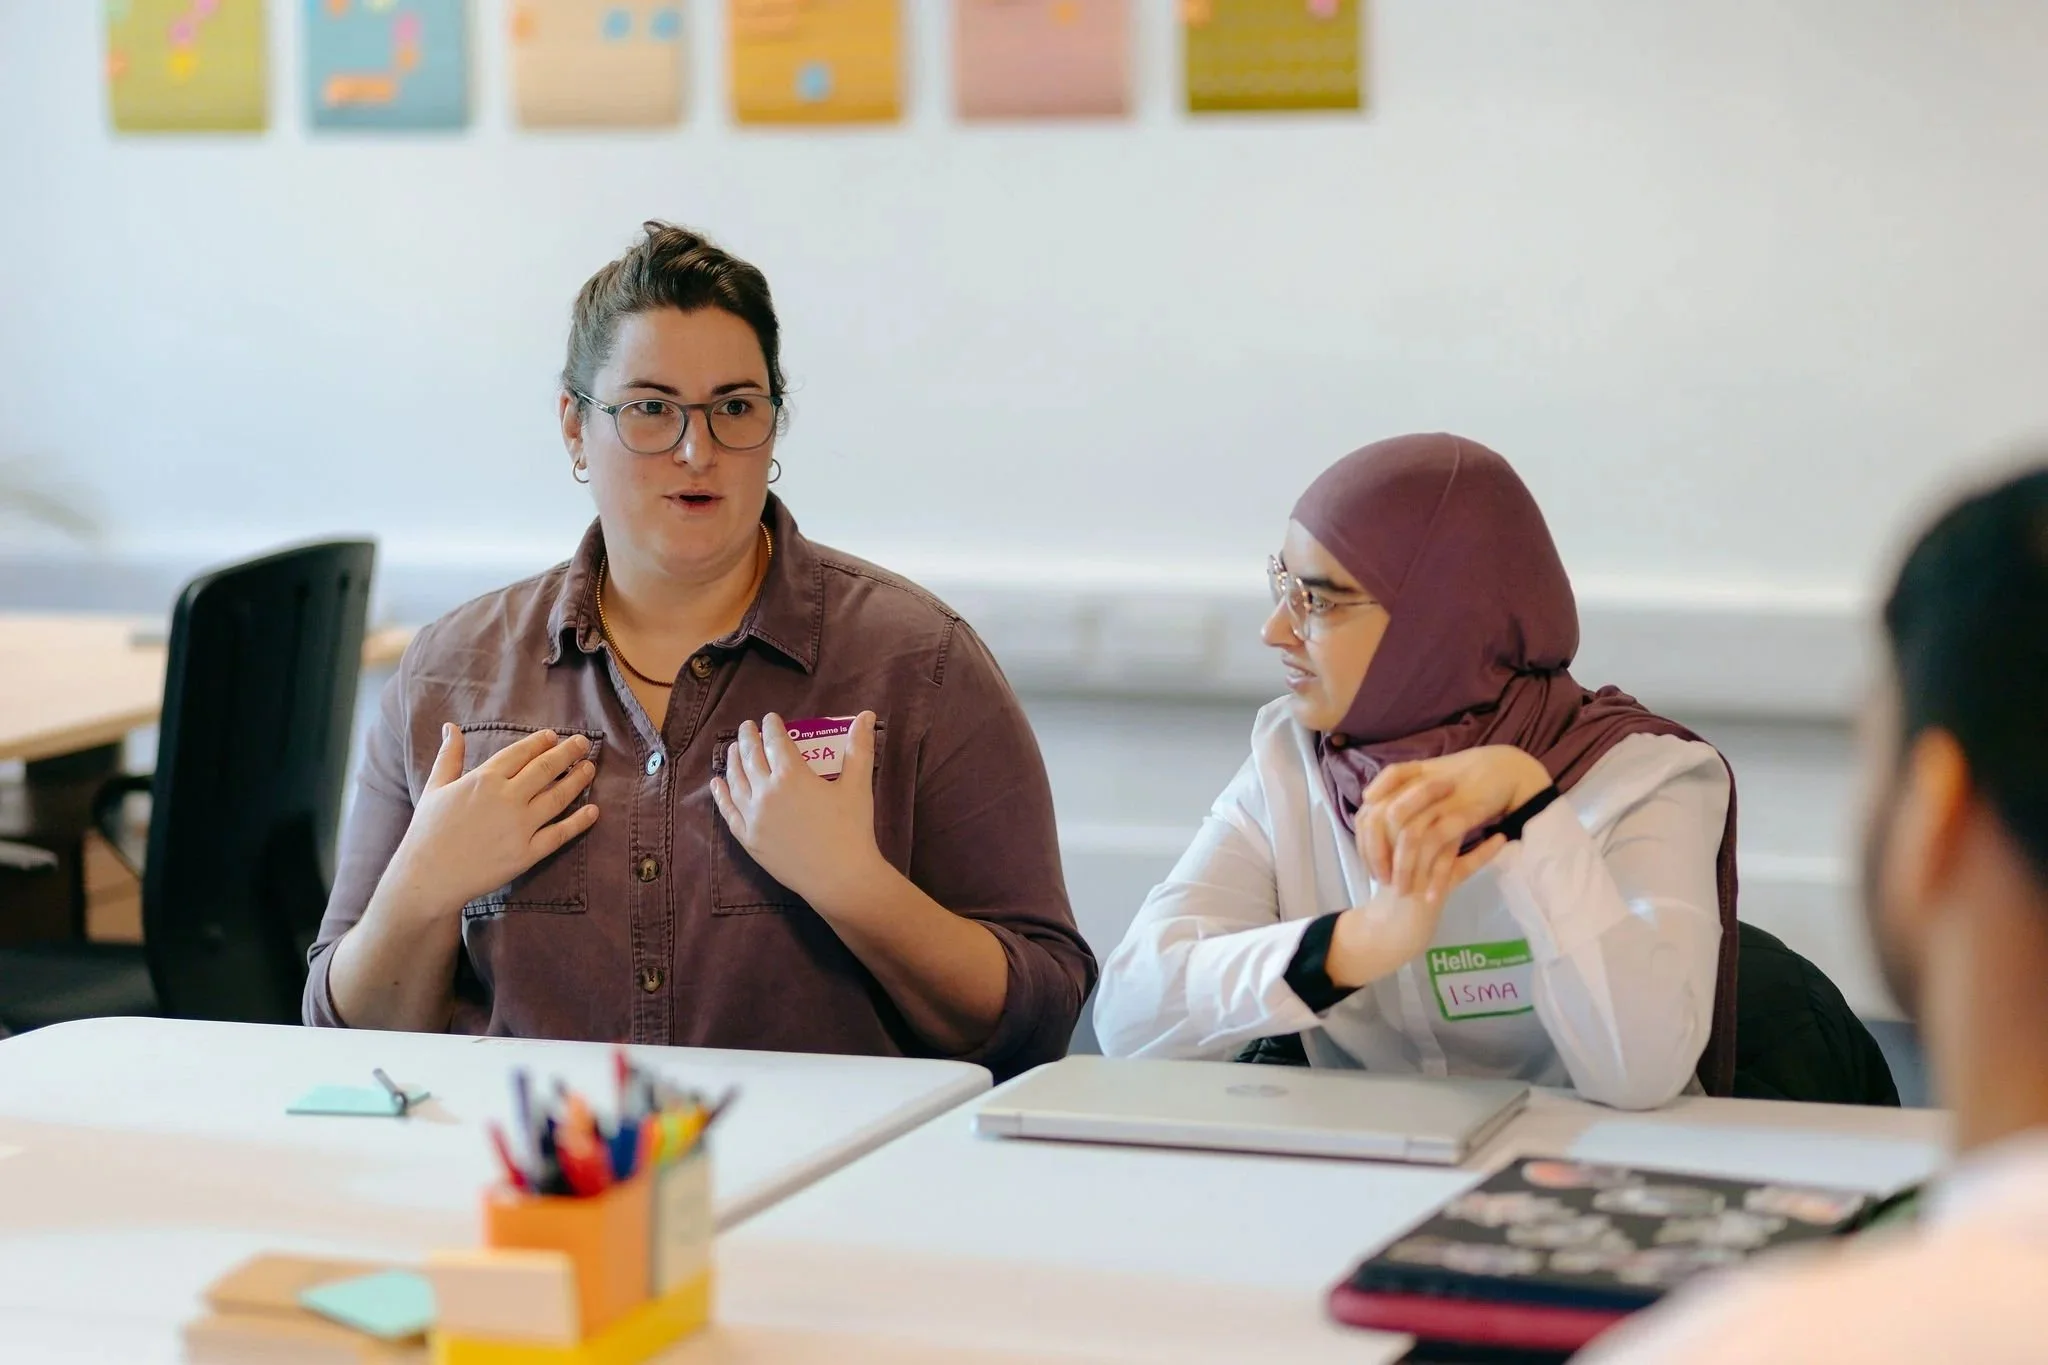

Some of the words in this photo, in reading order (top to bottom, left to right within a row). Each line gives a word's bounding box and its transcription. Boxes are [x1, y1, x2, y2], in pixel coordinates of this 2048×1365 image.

[816, 728, 839, 736] name
[1431, 949, 1485, 972] Hello
[1449, 982, 1518, 1005] ISMA
